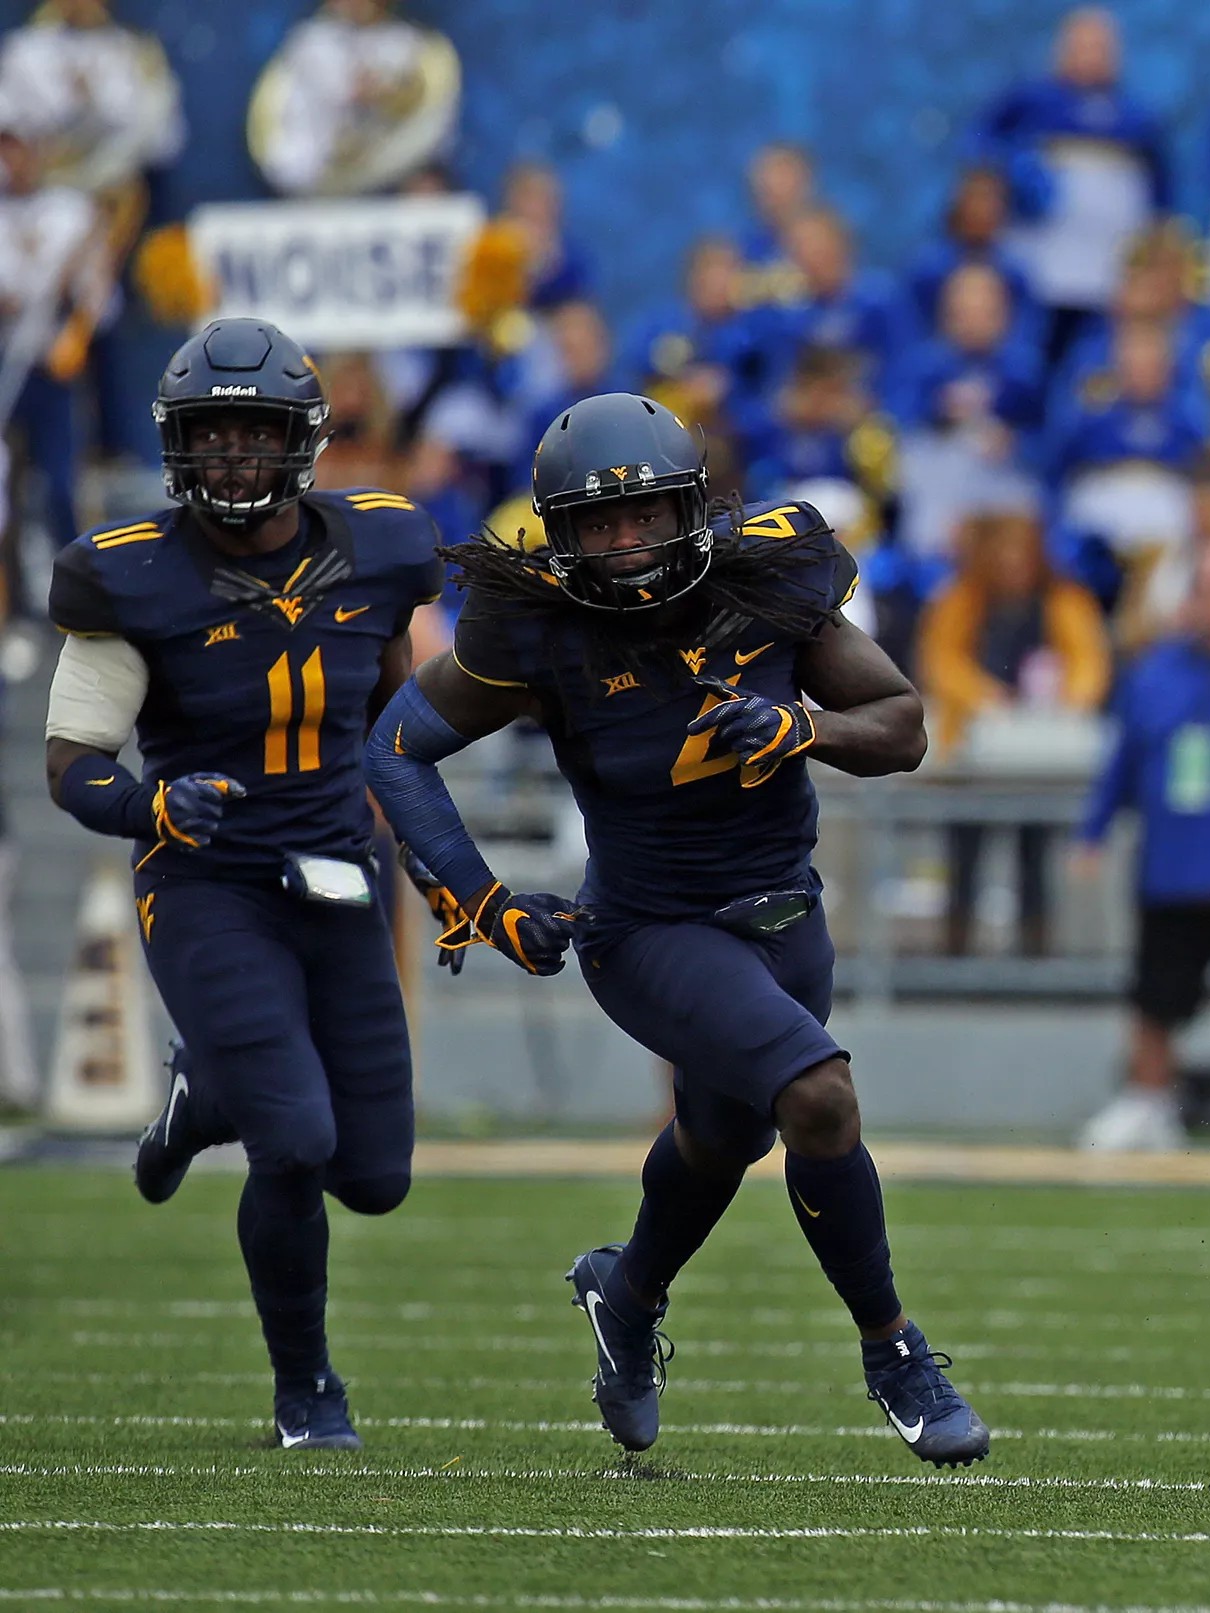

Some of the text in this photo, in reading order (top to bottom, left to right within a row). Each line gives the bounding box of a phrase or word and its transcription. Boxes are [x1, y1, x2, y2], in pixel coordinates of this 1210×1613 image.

[217, 235, 447, 312] NOISE
[212, 385, 257, 397] Riddell
[204, 621, 242, 647] XII
[600, 671, 646, 698] XII
[264, 645, 326, 775] 11
